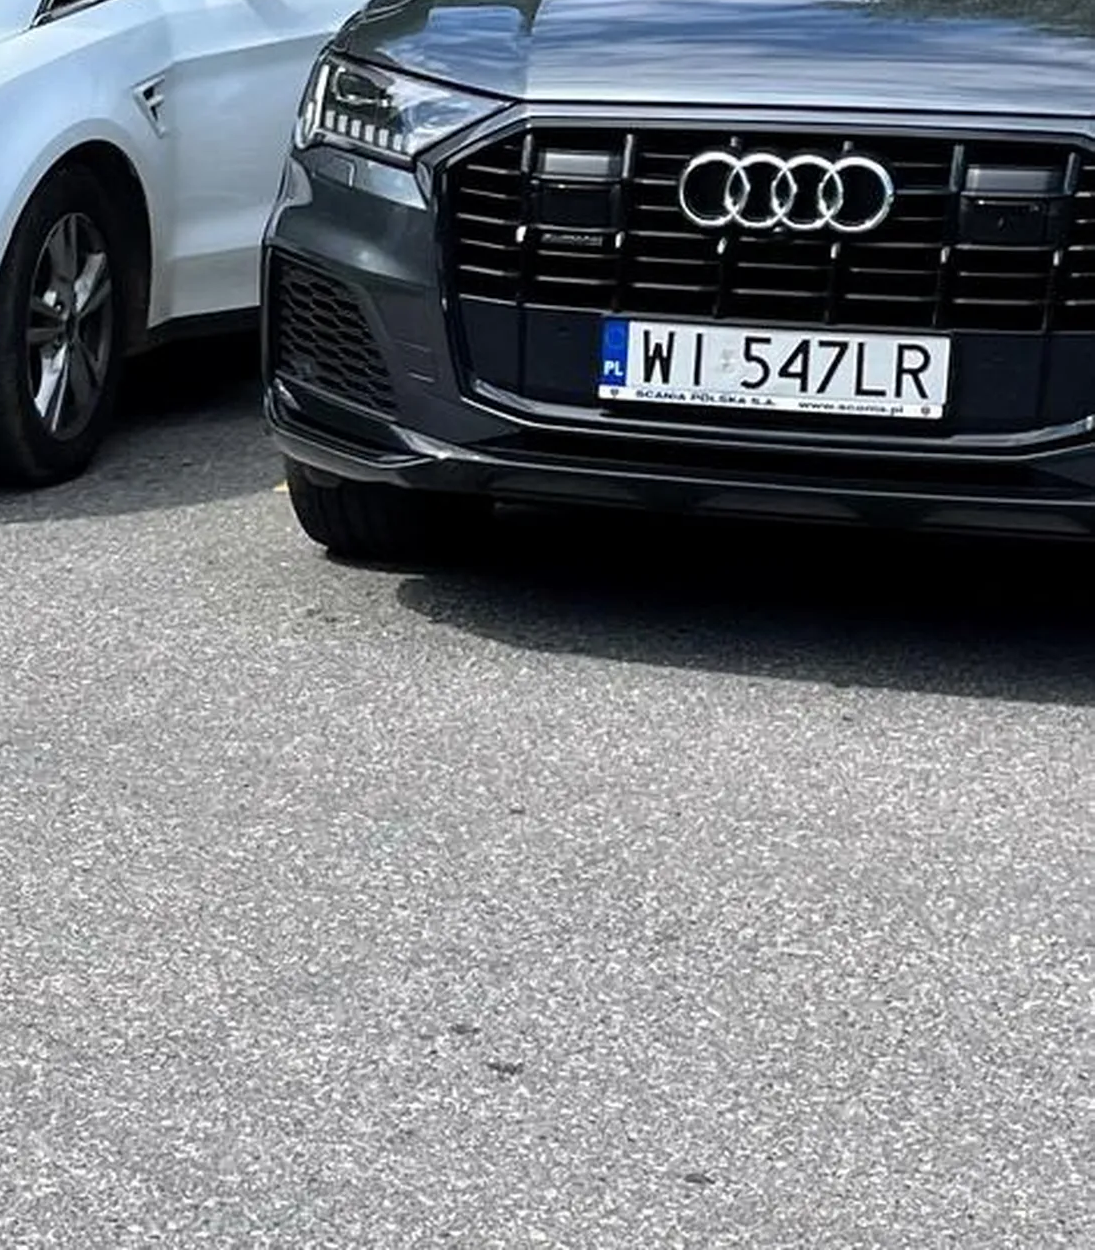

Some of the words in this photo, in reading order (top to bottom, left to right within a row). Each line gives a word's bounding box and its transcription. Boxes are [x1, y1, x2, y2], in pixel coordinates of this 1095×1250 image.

[604, 360, 625, 377] PL
[642, 329, 703, 386] WI
[739, 335, 931, 399] 547LR
